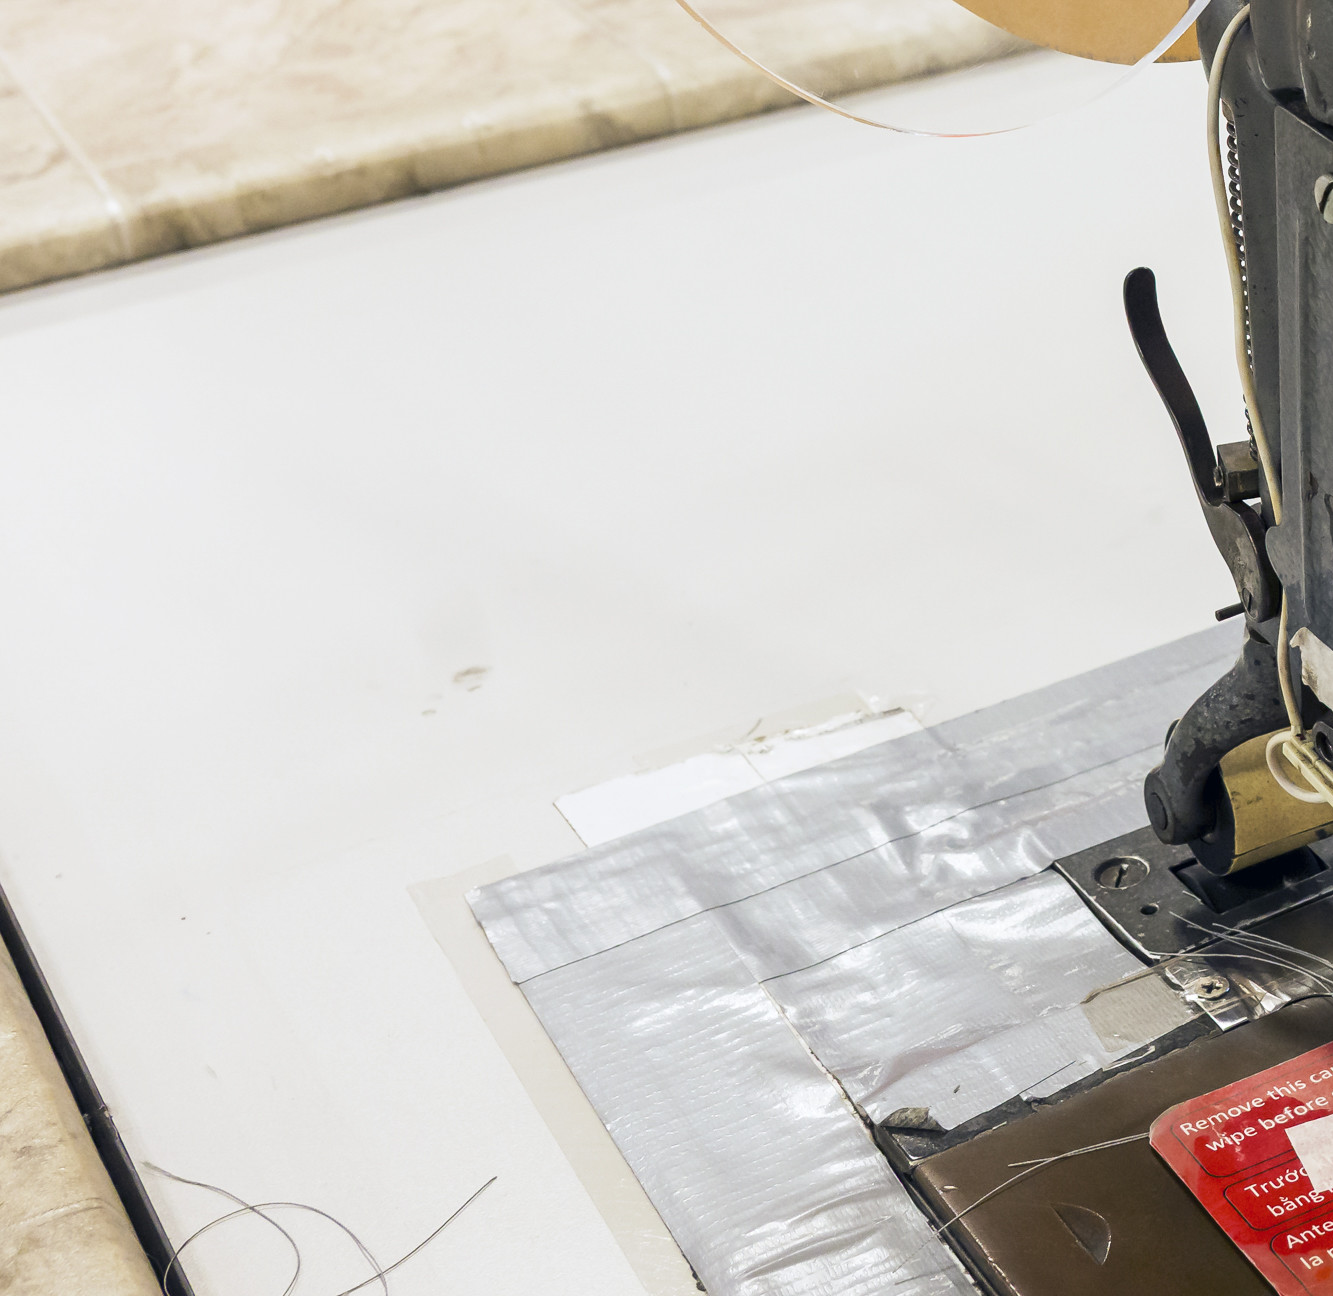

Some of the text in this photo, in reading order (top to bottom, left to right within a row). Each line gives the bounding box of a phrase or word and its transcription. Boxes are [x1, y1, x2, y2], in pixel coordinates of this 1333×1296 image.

[1180, 1095, 1265, 1135] Remove
[1267, 1079, 1306, 1101] this
[1205, 1125, 1257, 1152] wipe
[1259, 1094, 1328, 1130] before
[1300, 1253, 1324, 1271] la
